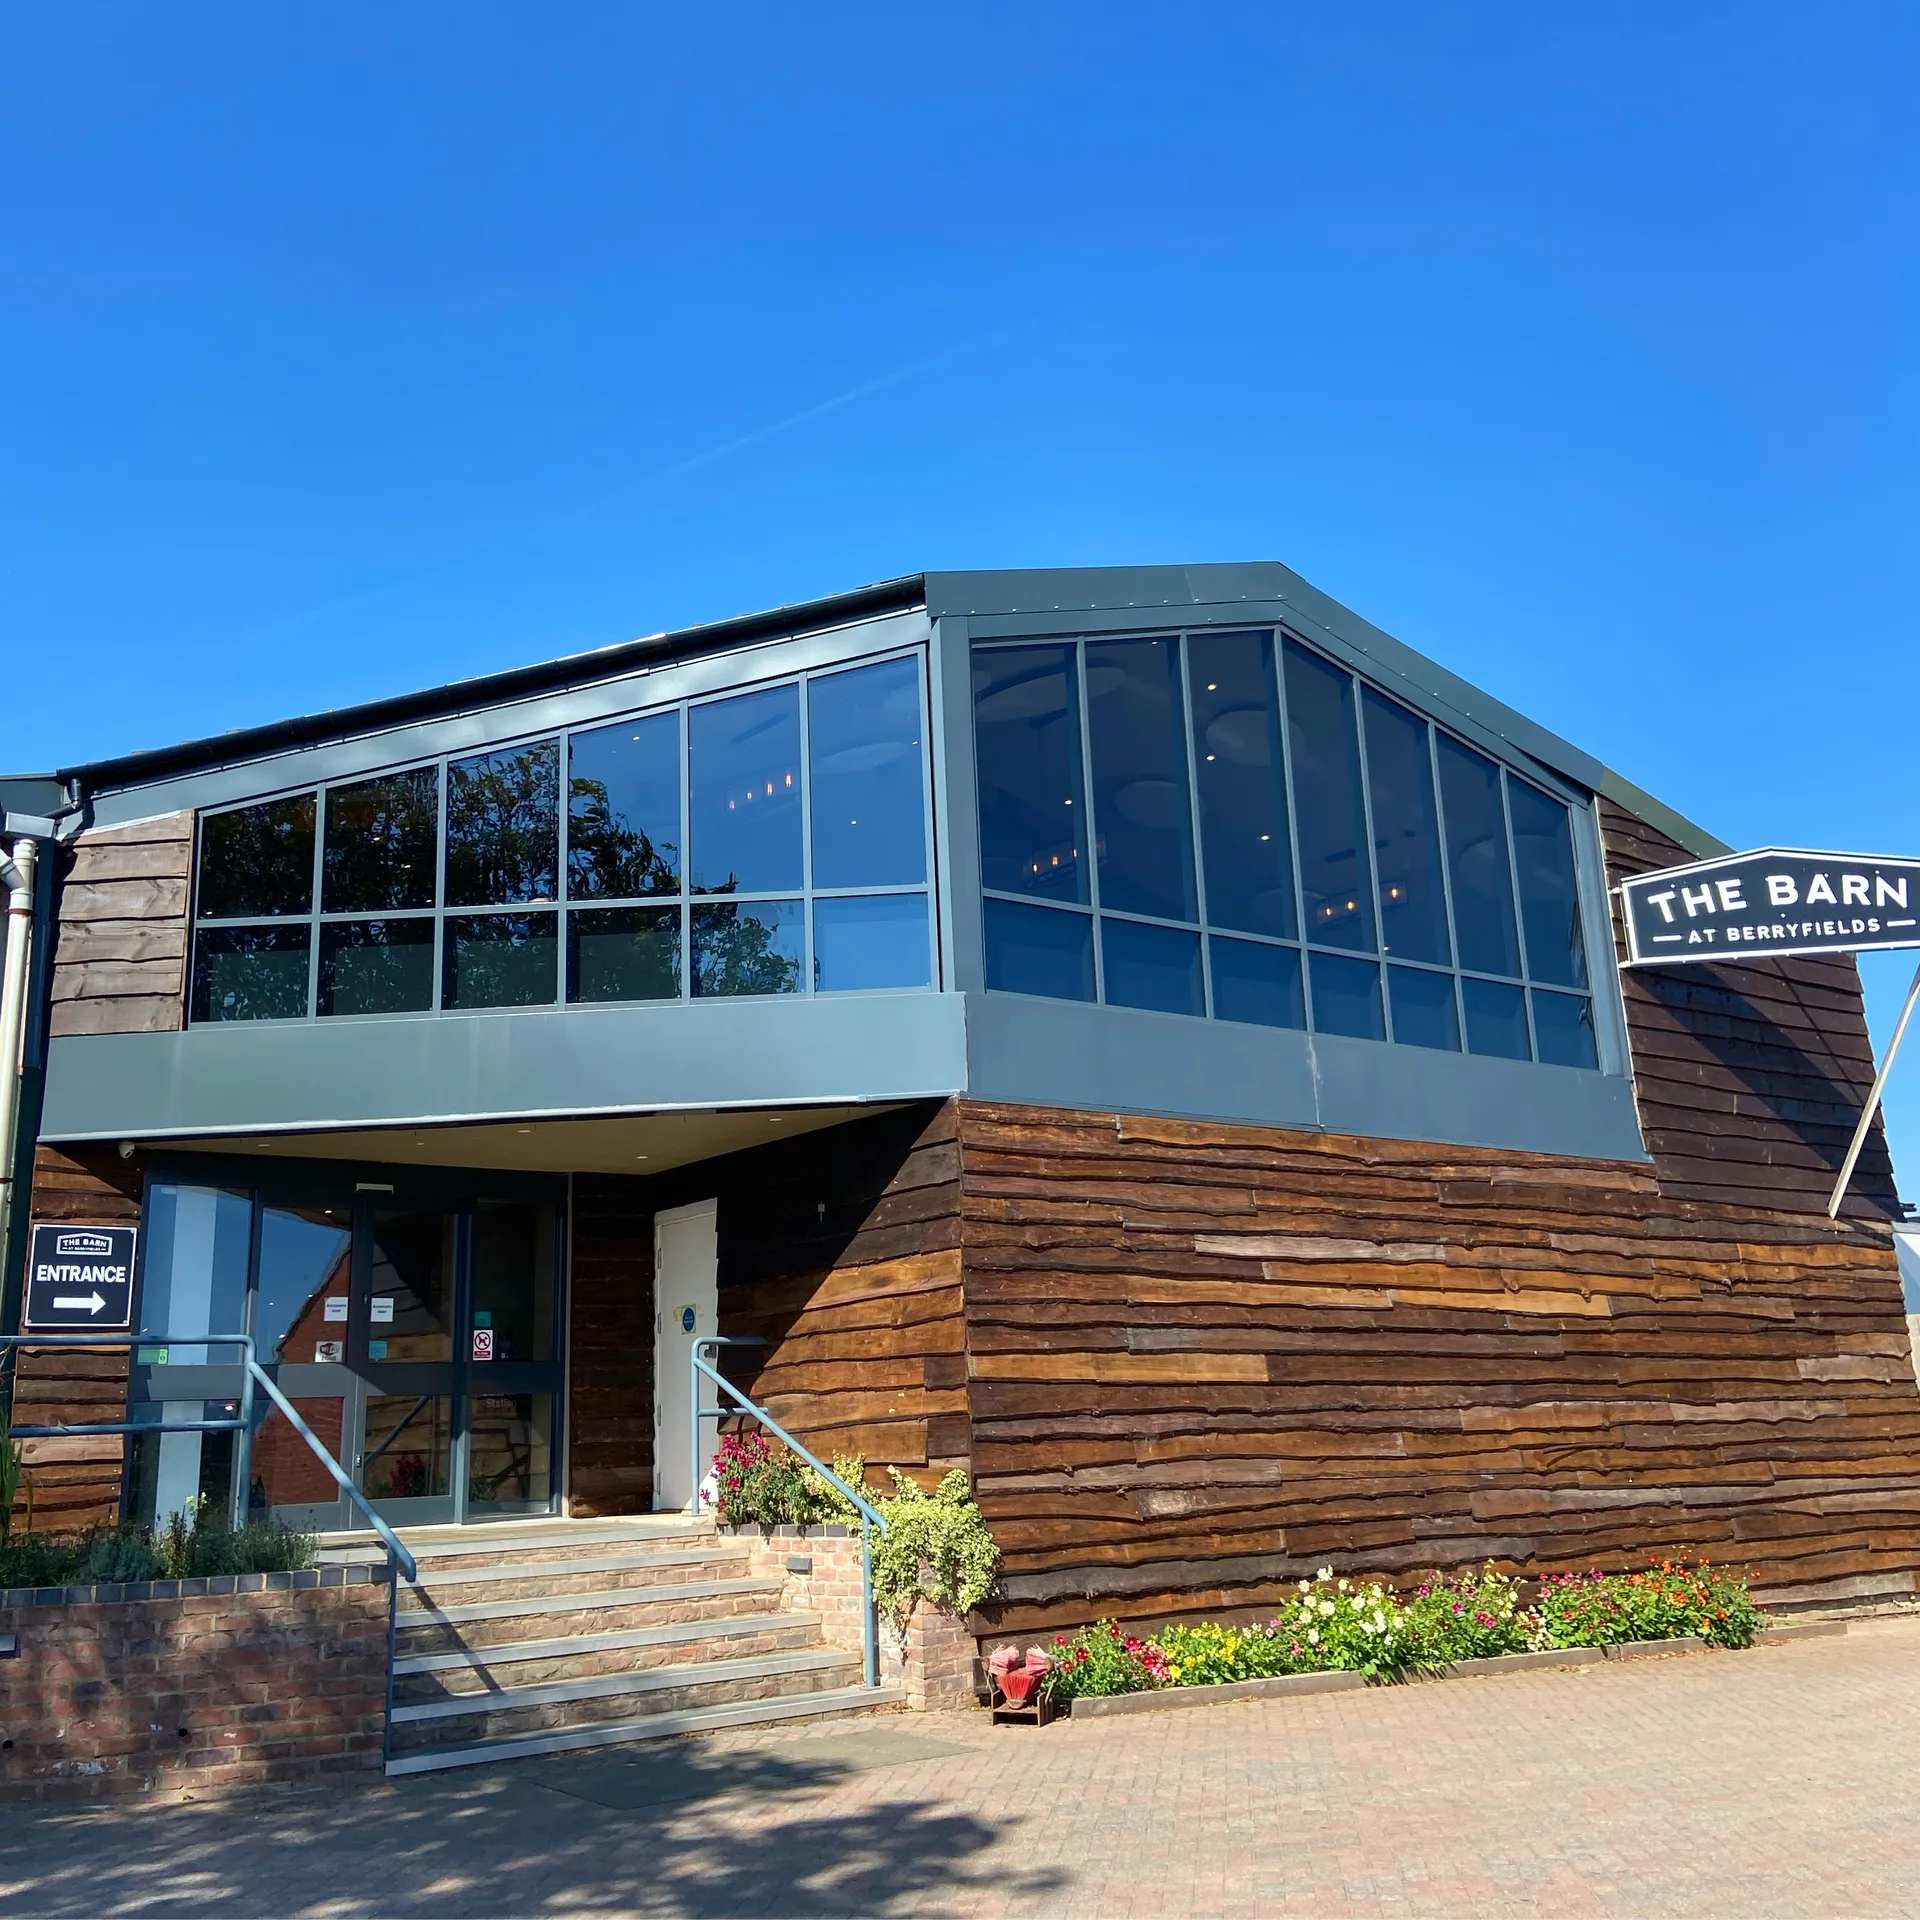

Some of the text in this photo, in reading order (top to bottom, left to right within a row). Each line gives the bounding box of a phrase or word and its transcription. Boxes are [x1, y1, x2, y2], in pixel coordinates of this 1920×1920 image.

[1647, 873, 1908, 923] THE BARN
[1688, 917, 1880, 944] AT BERRYFIELDS
[83, 1239, 107, 1247] BARN
[37, 1265, 126, 1282] ENTRANCE
